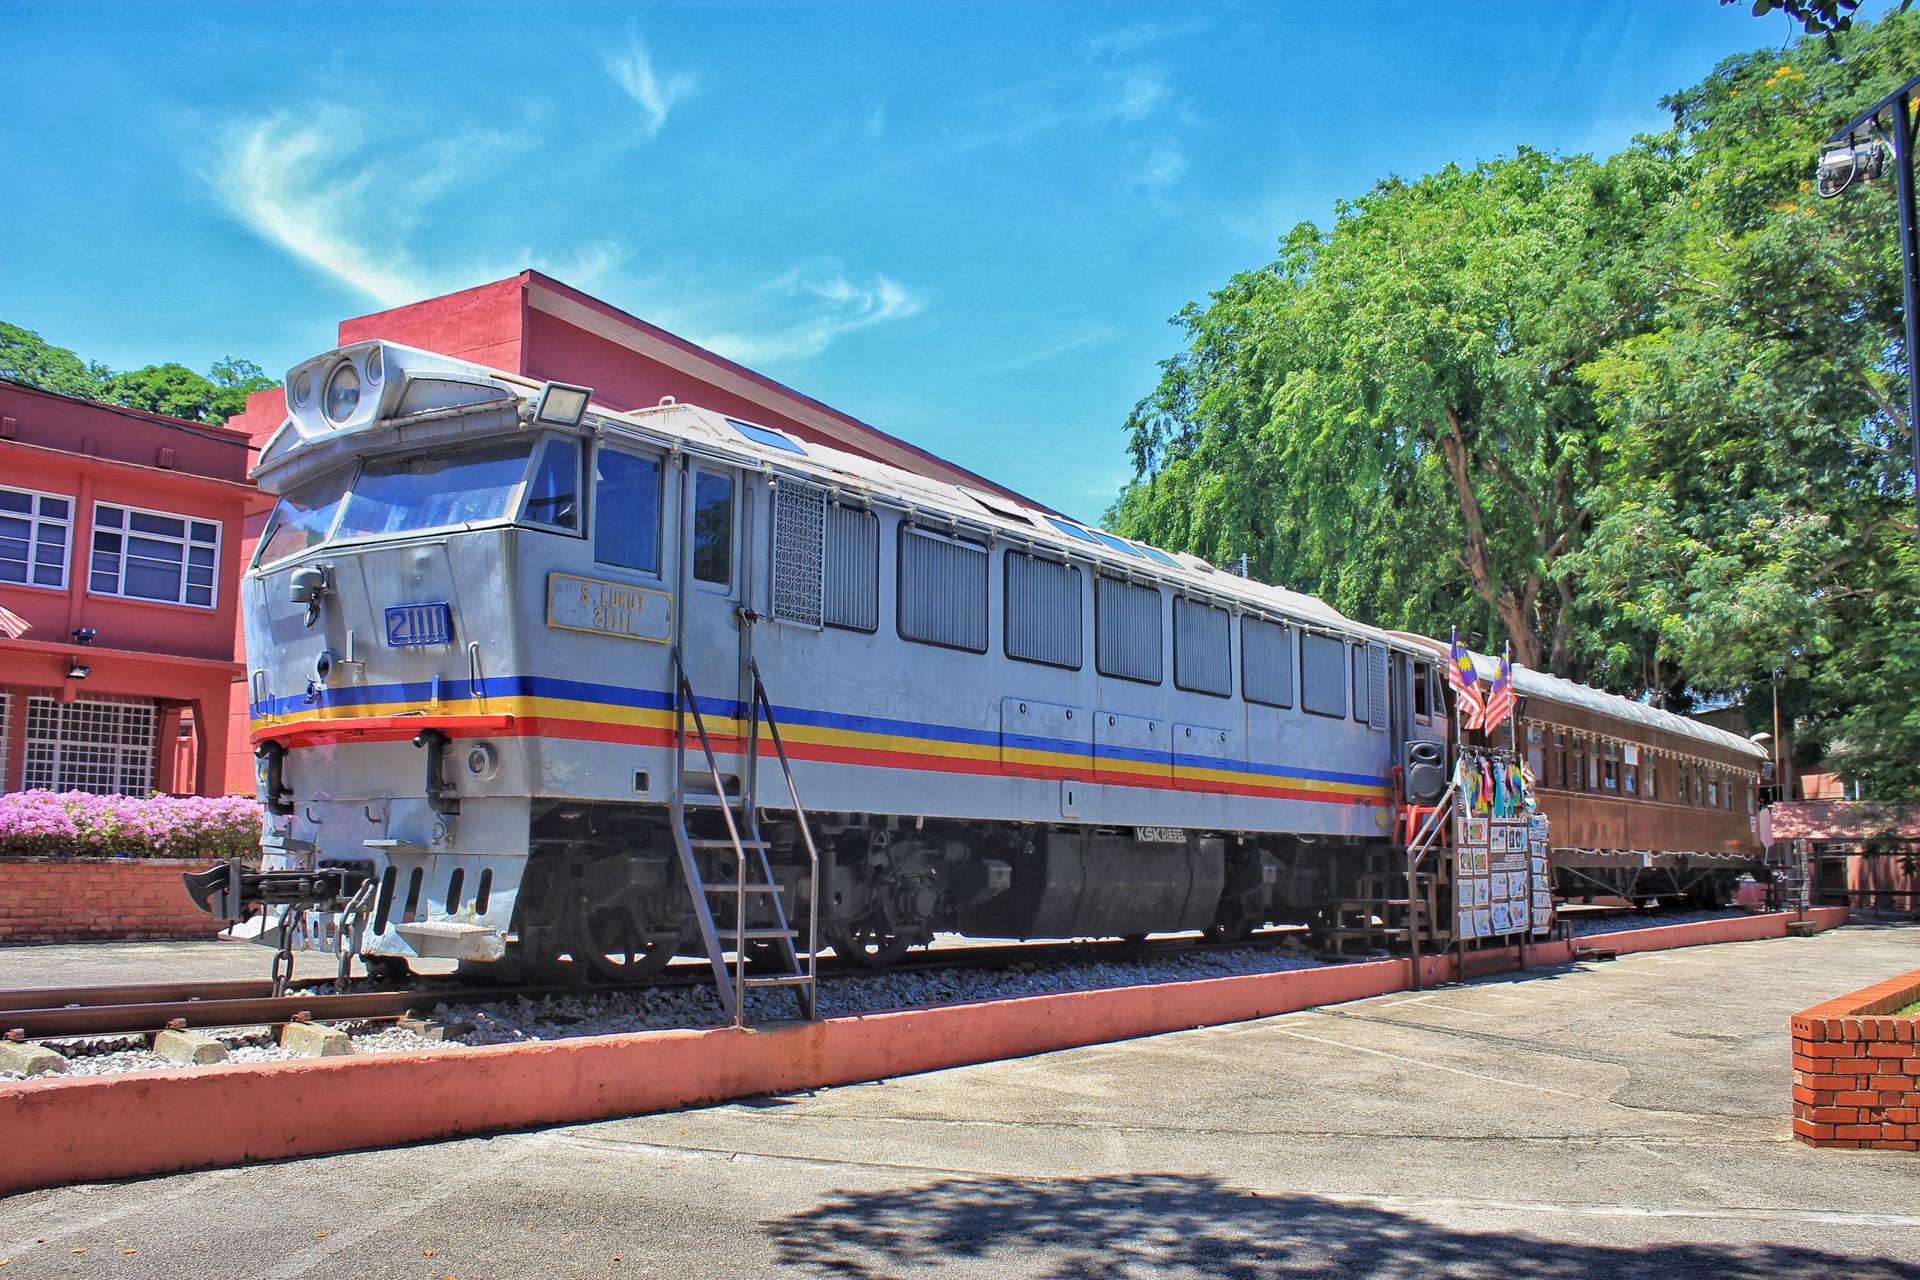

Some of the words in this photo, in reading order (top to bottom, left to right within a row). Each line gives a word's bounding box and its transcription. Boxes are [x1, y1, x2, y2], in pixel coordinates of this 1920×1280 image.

[390, 608, 443, 641] 21111
[593, 607, 633, 632] 21111
[1136, 827, 1161, 842] KSK
[1161, 828, 1186, 841] DIESEL
